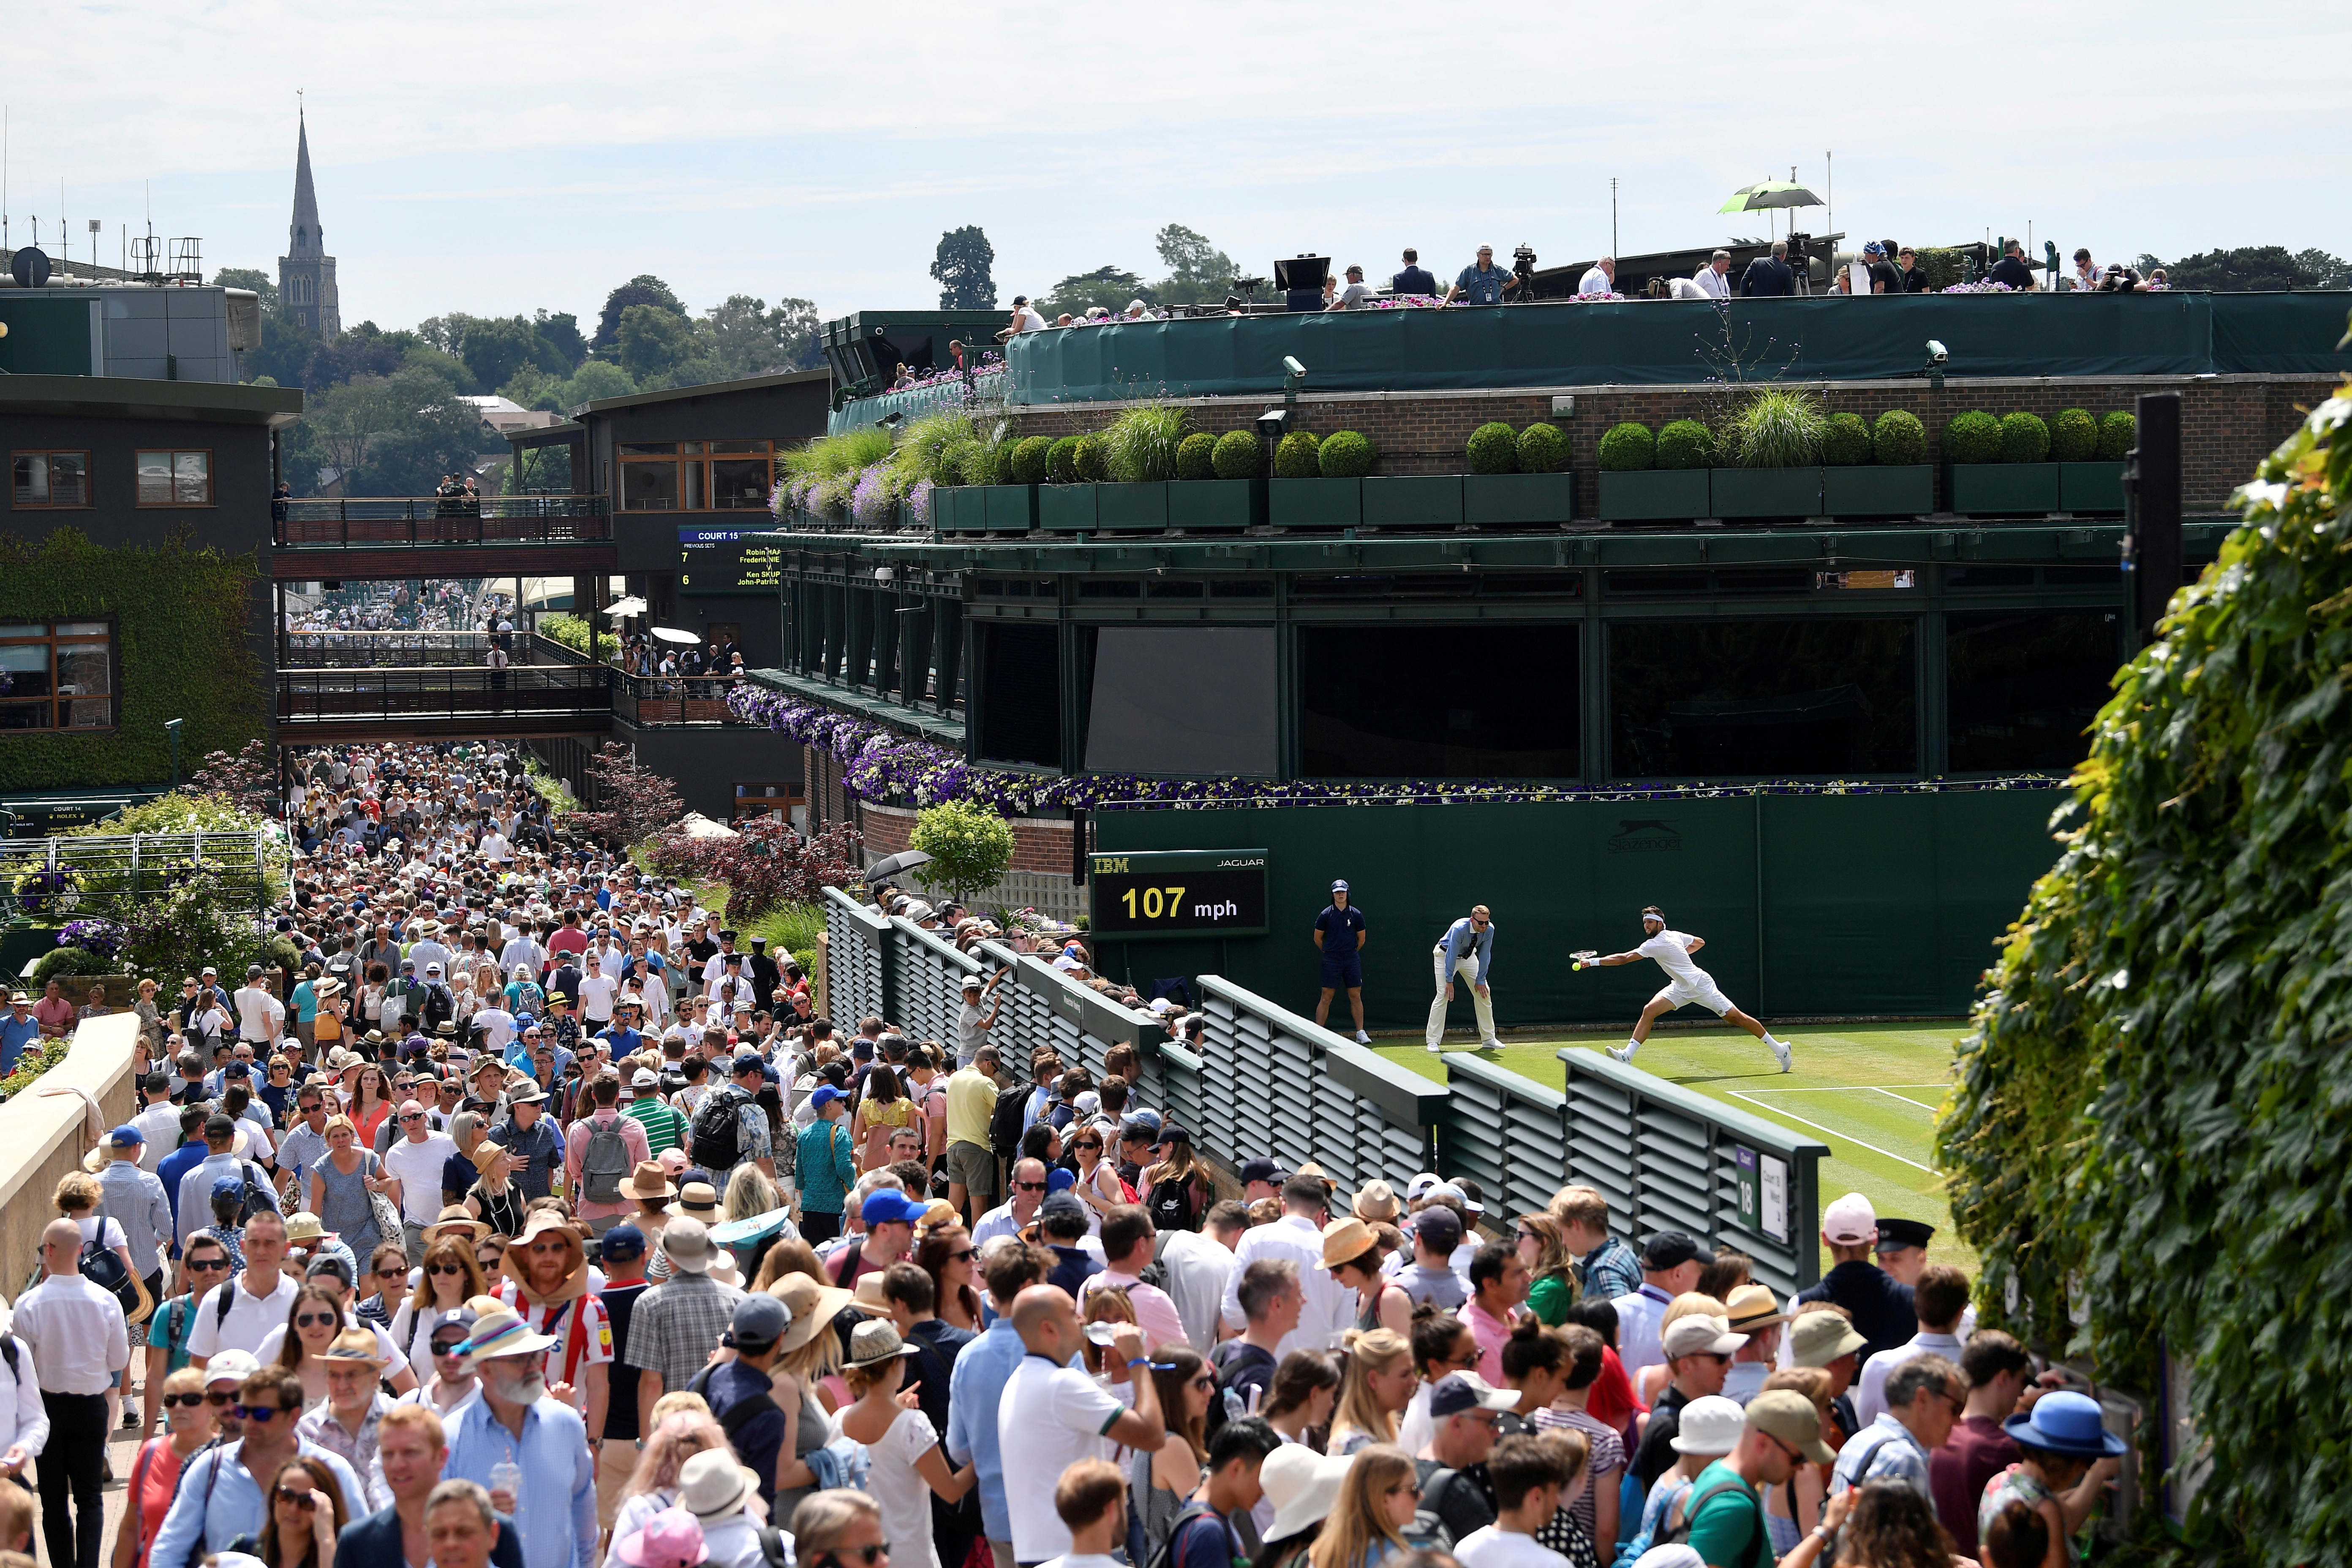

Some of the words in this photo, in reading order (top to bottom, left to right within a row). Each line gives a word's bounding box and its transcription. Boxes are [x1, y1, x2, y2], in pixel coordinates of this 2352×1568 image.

[698, 532, 727, 540] COURT
[729, 532, 738, 540] 15
[681, 552, 688, 562] 7
[682, 575, 689, 585] 6
[1607, 838, 1682, 851] Slazenger
[1094, 858, 1130, 874] IBM
[1217, 858, 1264, 867] JAGUAR
[1122, 887, 1186, 919] 107
[1195, 900, 1237, 920] mph
[1740, 1180, 1753, 1215] 18
